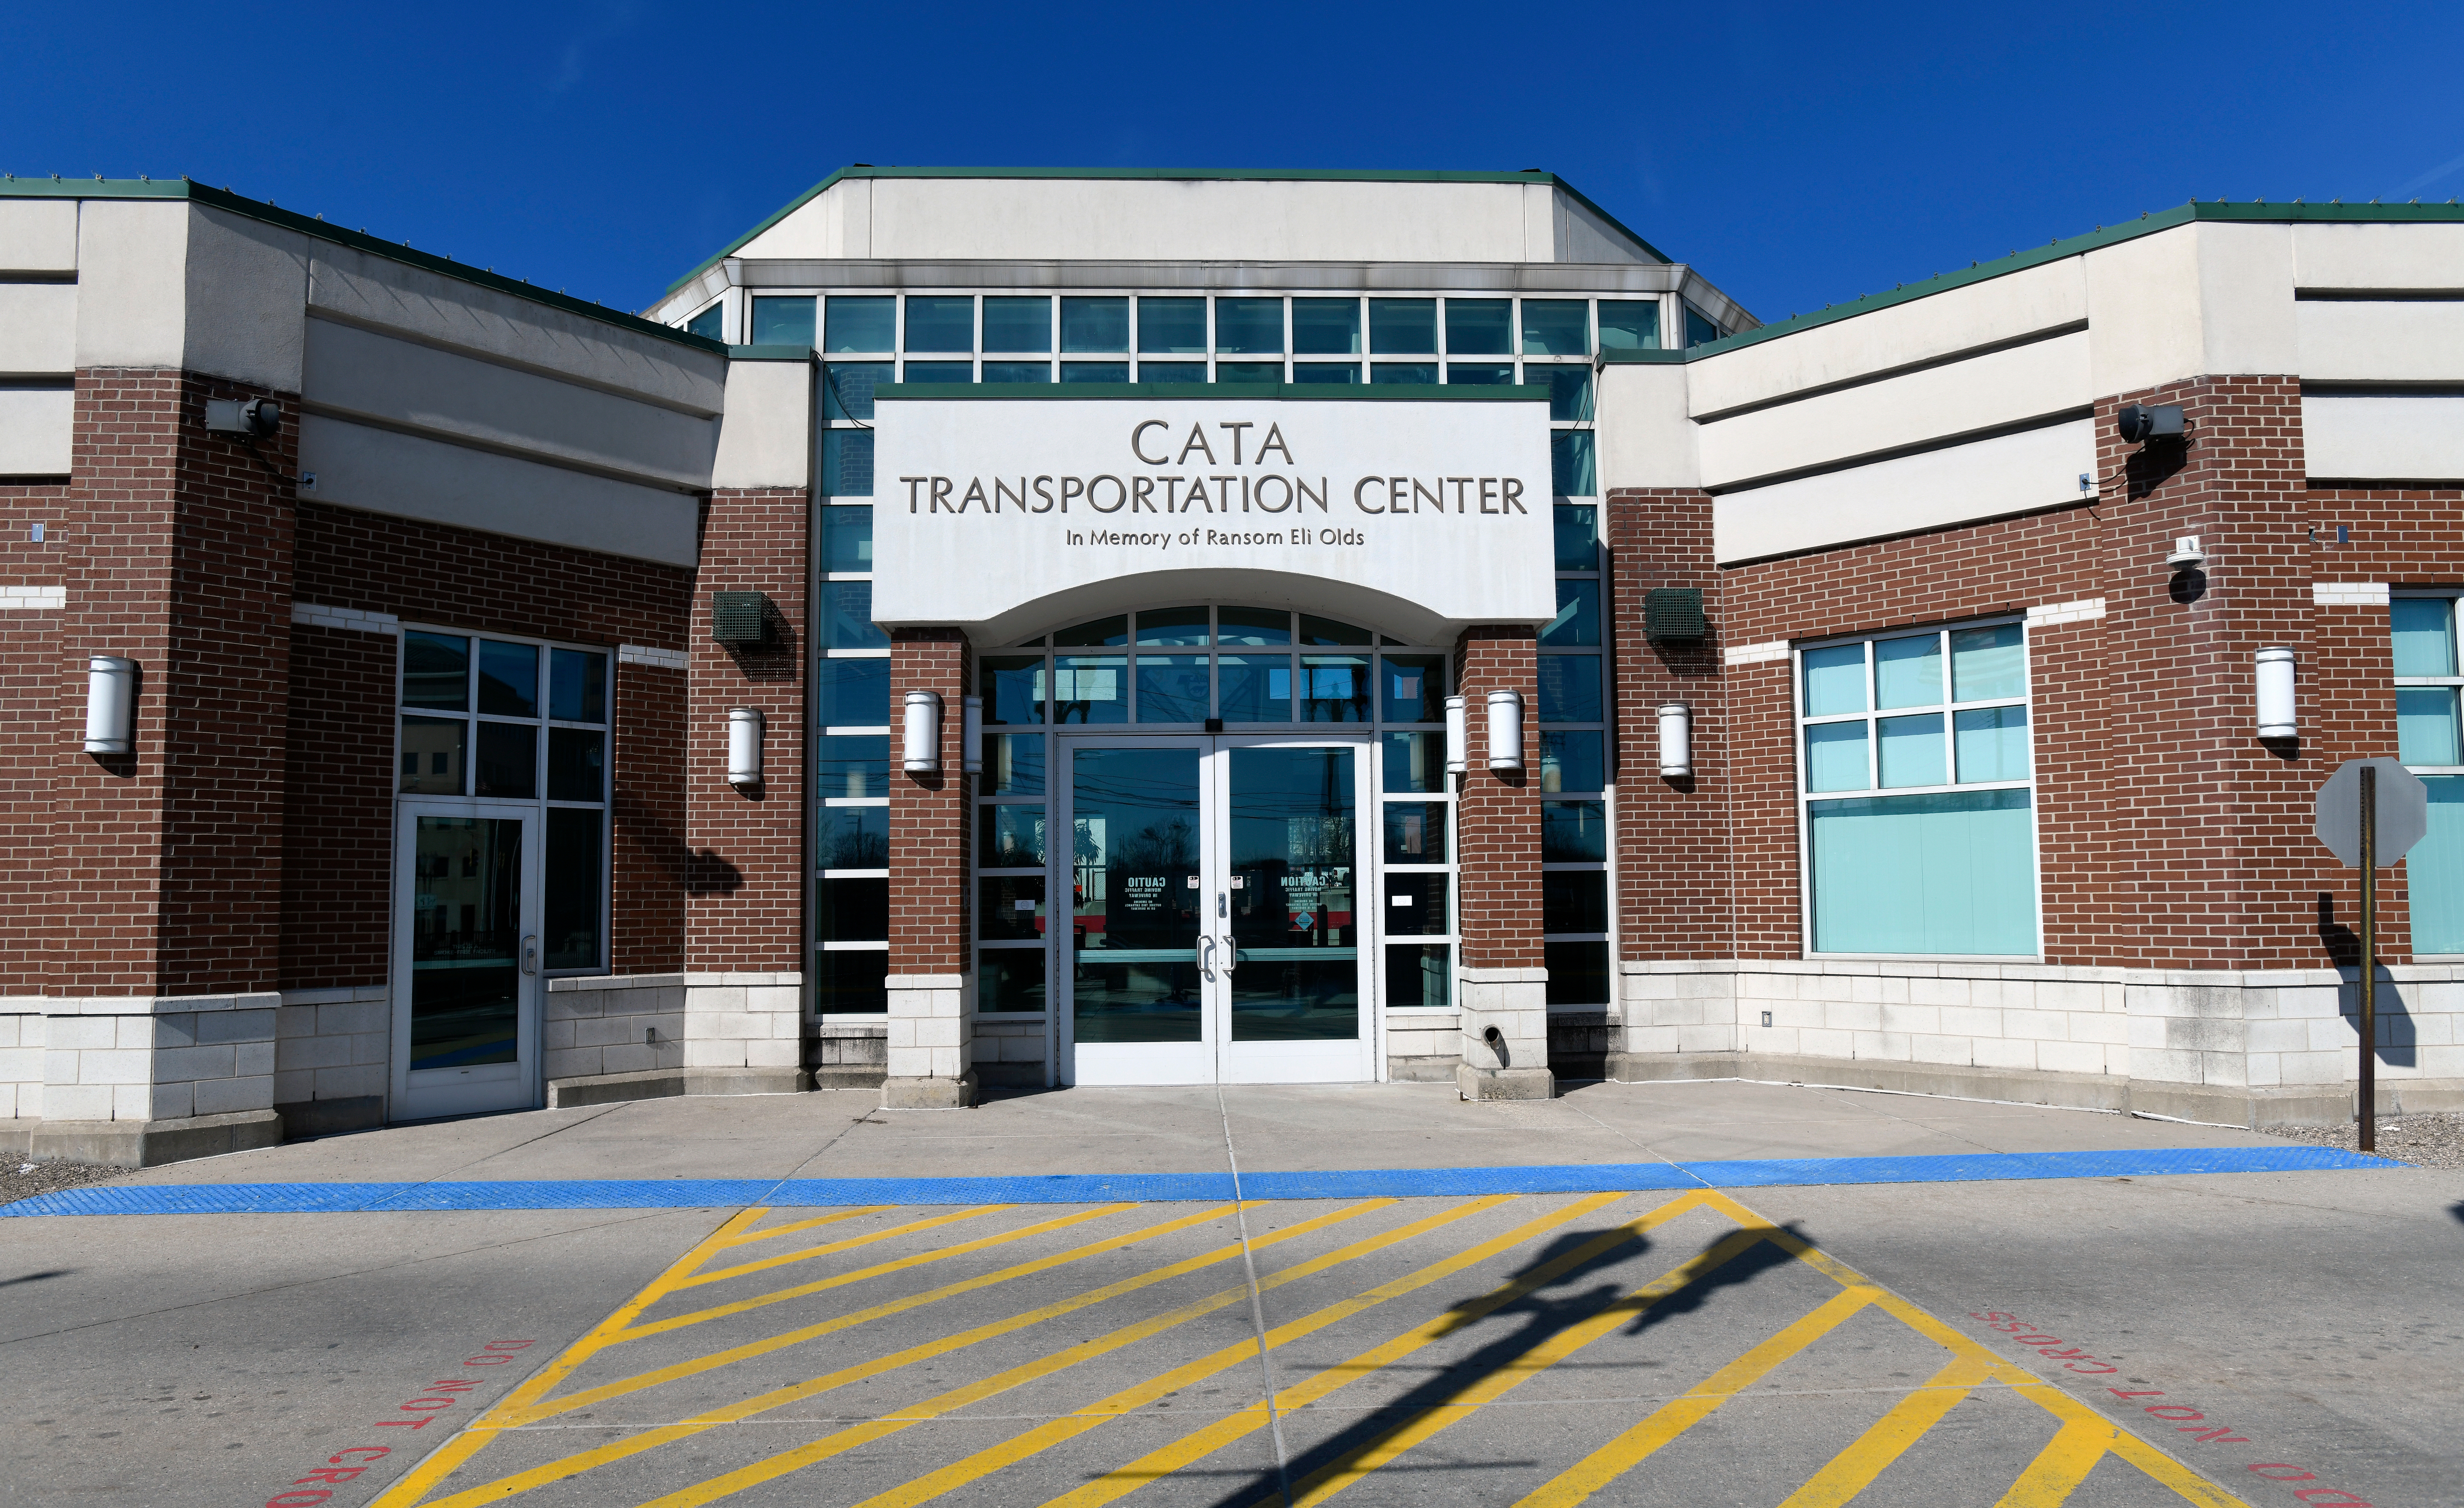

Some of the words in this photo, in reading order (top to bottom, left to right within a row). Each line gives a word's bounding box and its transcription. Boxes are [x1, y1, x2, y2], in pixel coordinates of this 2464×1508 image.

[1132, 419, 1295, 466] CATA
[899, 474, 1328, 515] TRANSPORTATION
[1354, 476, 1529, 515] CENTER
[1067, 530, 1084, 546] In
[1090, 530, 1172, 551] Memory
[1178, 528, 1200, 546] of
[1207, 529, 1284, 546] Ransom
[1291, 528, 1312, 546] Eli
[1320, 528, 1365, 546] Olds
[463, 1339, 536, 1367] DO
[1969, 1311, 2118, 1374] CROSS
[373, 1380, 485, 1430] NOT
[2105, 1386, 2252, 1443] NOT
